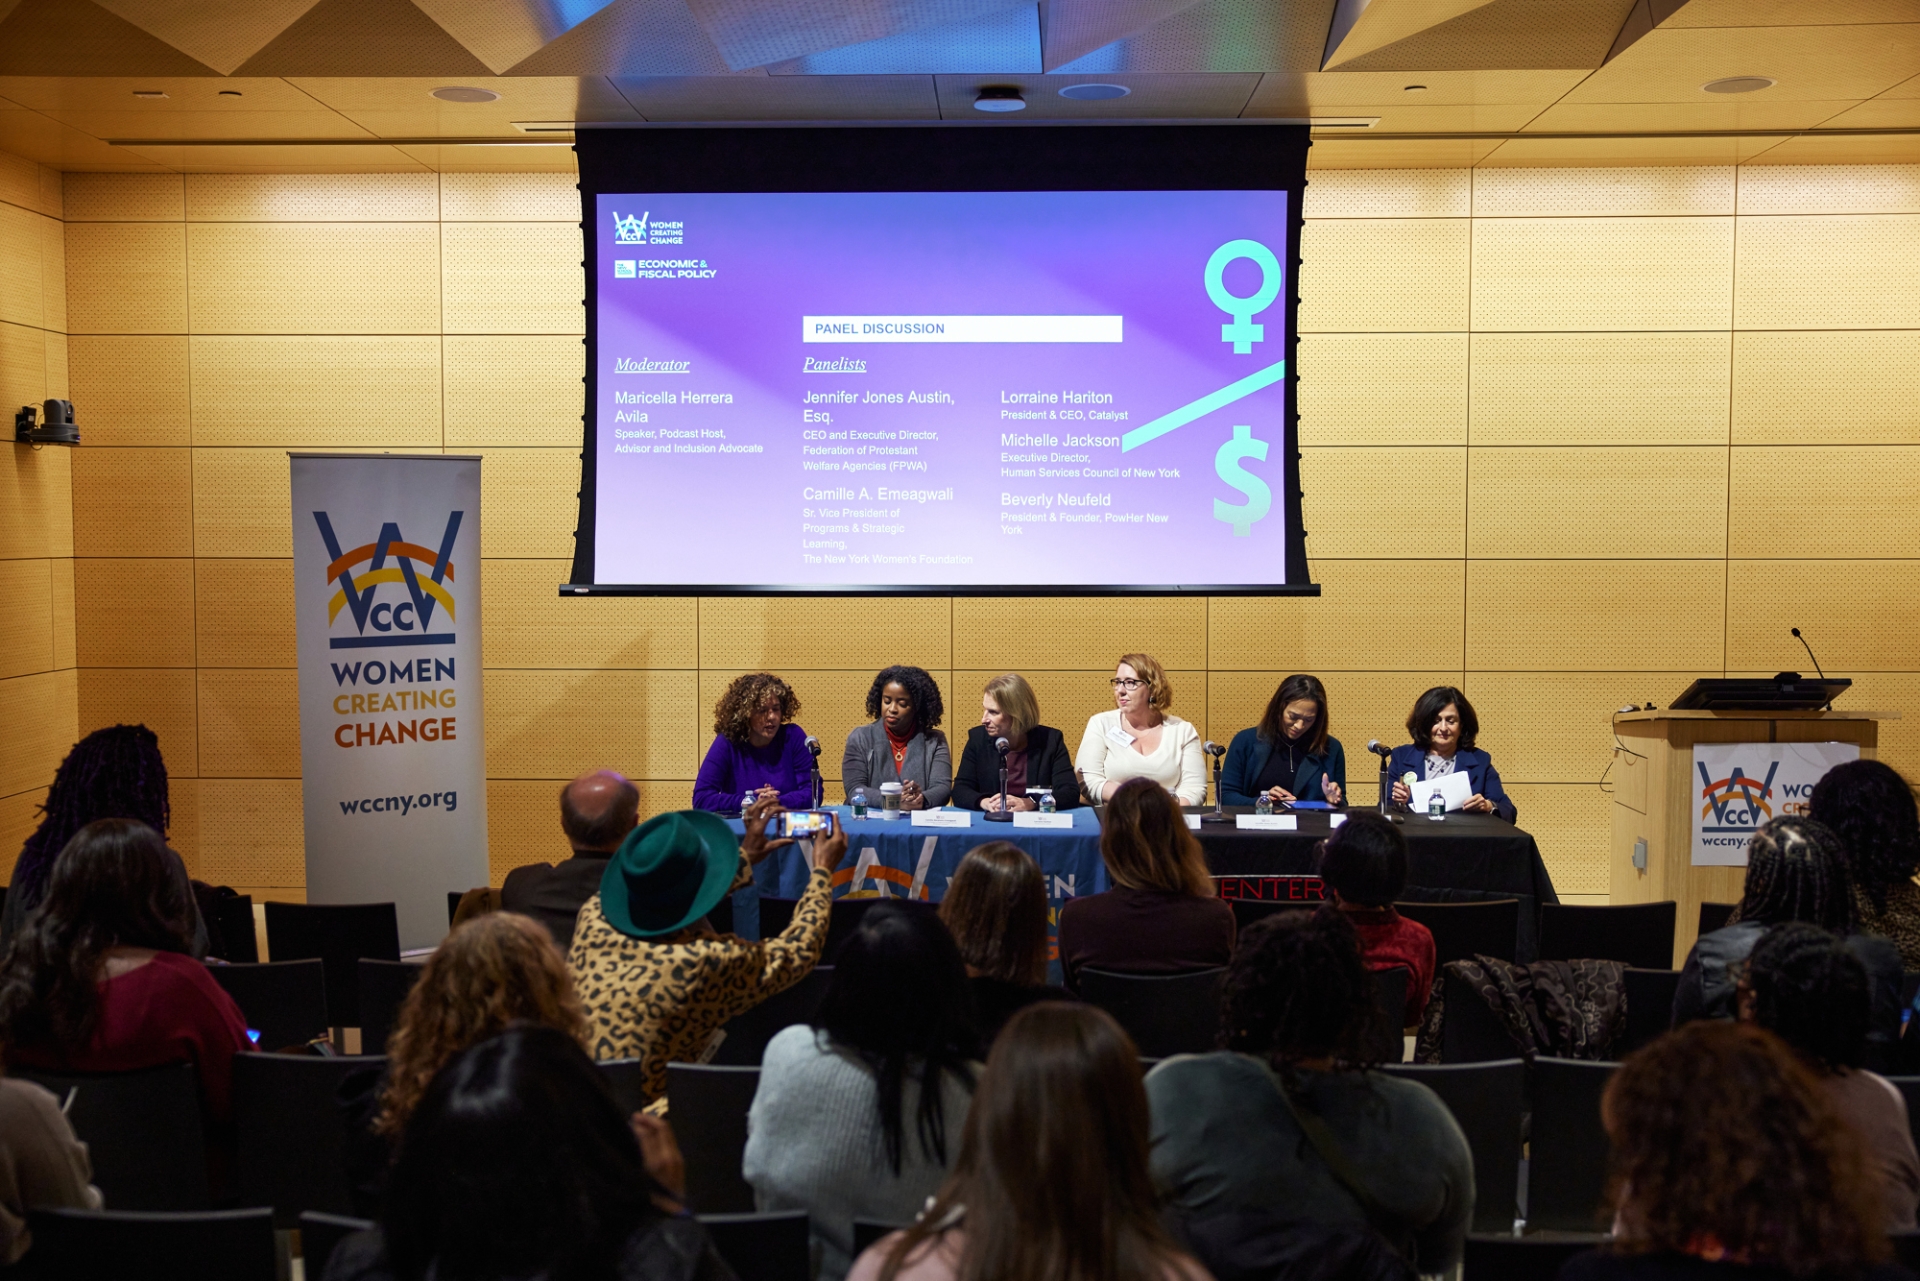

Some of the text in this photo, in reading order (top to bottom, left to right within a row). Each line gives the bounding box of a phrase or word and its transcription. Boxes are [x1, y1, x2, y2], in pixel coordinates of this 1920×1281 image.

[650, 221, 683, 229] WOMEN
[638, 259, 708, 268] ECONOMIC &
[638, 270, 717, 278] FISCAL POLICY
[815, 323, 945, 334] PANEL DISCUSSION
[615, 357, 690, 372] Moderator
[803, 357, 867, 372] Panelists
[615, 390, 733, 404] Maricella Herrera
[803, 390, 955, 406] Jennifer Jones Austin,
[1001, 390, 1113, 404] Lorraine Hariton
[615, 409, 648, 422] Avila
[803, 409, 834, 425] Esq.
[1001, 409, 1128, 422] President & CEO, Catalyst
[615, 428, 726, 440] Speaker, Podcast Host,
[803, 430, 939, 441] CEO and Executive Director,
[1001, 433, 1120, 447] Michelle Jackson
[615, 443, 763, 454] Advisor and Inclusion Advocate
[803, 445, 918, 455] Federation of Protestant
[1001, 452, 1091, 464] Executive Director,
[803, 460, 927, 473] Welfare Agencies (FPWA)
[1001, 467, 1181, 478] Human Services Council of New York
[803, 487, 954, 503] Camille A. Emeagwali
[1001, 492, 1111, 508] Beverly Neufeld
[803, 508, 901, 518] Sr. Vice President of
[1001, 513, 1169, 524] President & Founder, PowHer New
[803, 523, 905, 535] Programs & Strategic
[1001, 525, 1023, 535] York
[803, 539, 848, 551] Learning,
[803, 554, 973, 564] The New York Women's Foundation
[330, 657, 456, 688] WOMEN
[332, 688, 457, 716] CREATING
[334, 716, 457, 749] CHANGE
[339, 789, 458, 816] wccny.org
[1702, 837, 1752, 849] wccny.
[1214, 878, 1325, 899] ENTER
